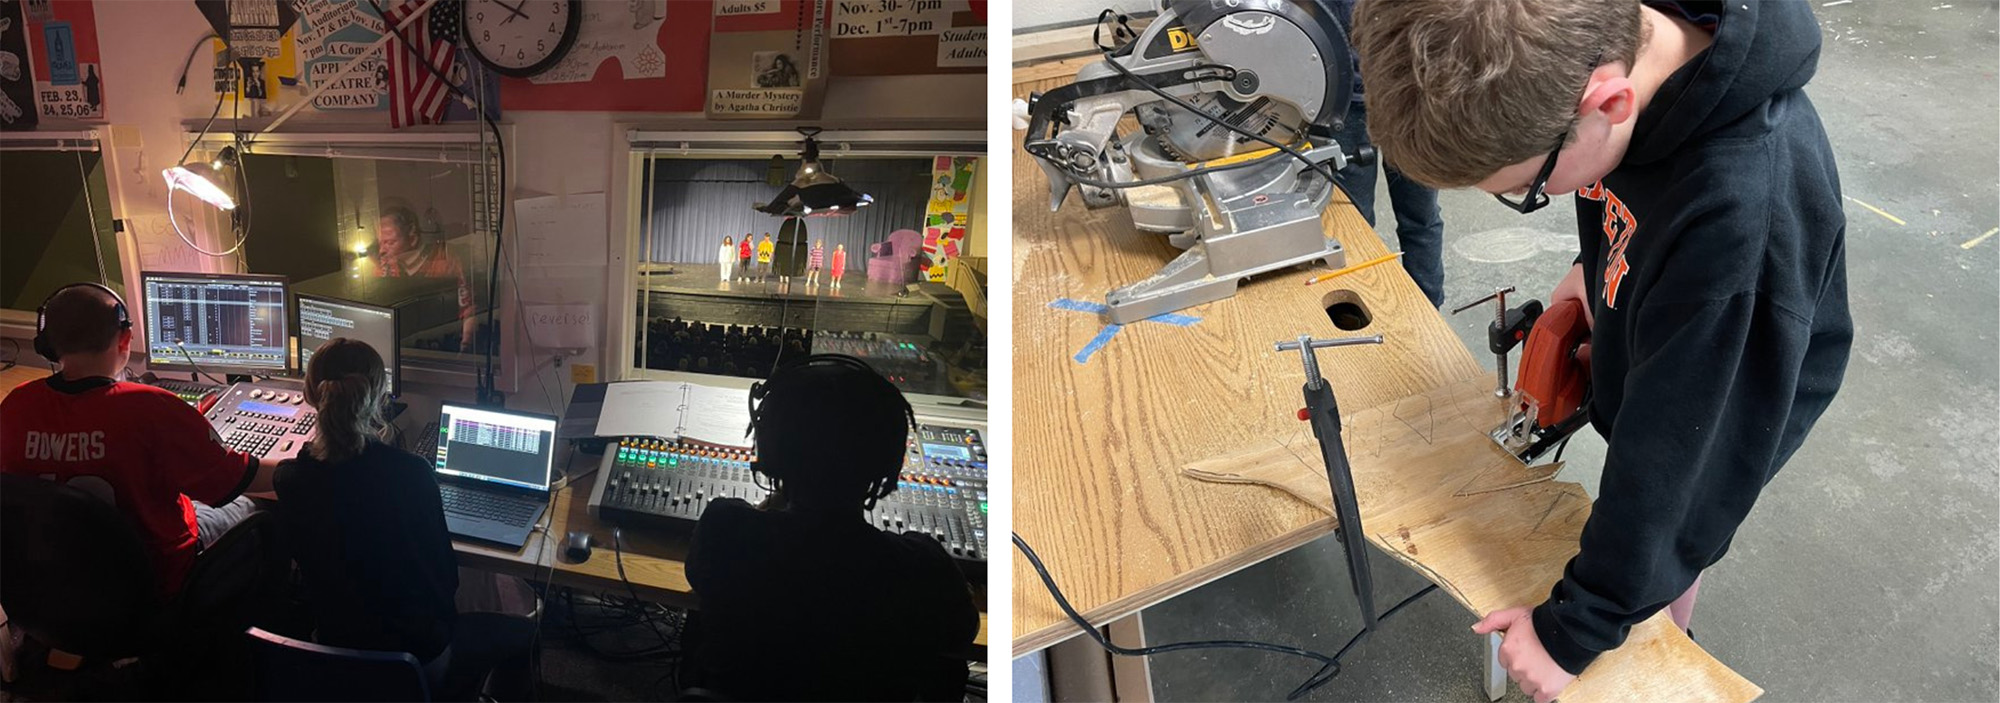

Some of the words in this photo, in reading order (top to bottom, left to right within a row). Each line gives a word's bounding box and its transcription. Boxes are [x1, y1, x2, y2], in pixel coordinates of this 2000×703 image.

[552, 2, 560, 14] 3
[720, 3, 752, 14] Adults
[839, 2, 873, 15] Nov.
[311, 0, 357, 29] Auditorium
[350, 10, 368, 26] Nov.
[476, 12, 484, 24] 9
[548, 22, 556, 33] 4
[837, 22, 870, 36] Dec.
[297, 35, 316, 46] Nov.
[316, 26, 326, 38] 17
[328, 23, 336, 32] &
[483, 30, 491, 42] 8
[303, 50, 308, 58] 7
[310, 45, 324, 58] pm
[328, 44, 336, 54] A
[339, 44, 384, 58] Comy
[499, 44, 506, 56] 7
[537, 39, 545, 52] 5
[810, 18, 824, 77] Performance
[517, 48, 525, 60] 6
[312, 61, 376, 74] APPLUSE
[313, 77, 372, 89] TATRE
[41, 91, 63, 102] FEB.
[65, 90, 82, 102] 23,
[313, 94, 377, 106] COMPANY
[726, 91, 760, 99] Murder
[764, 91, 800, 102] Mystery
[715, 103, 725, 111] by
[728, 103, 760, 112] Agatha
[762, 103, 799, 112] Christie
[24, 430, 106, 462] BOWERS
